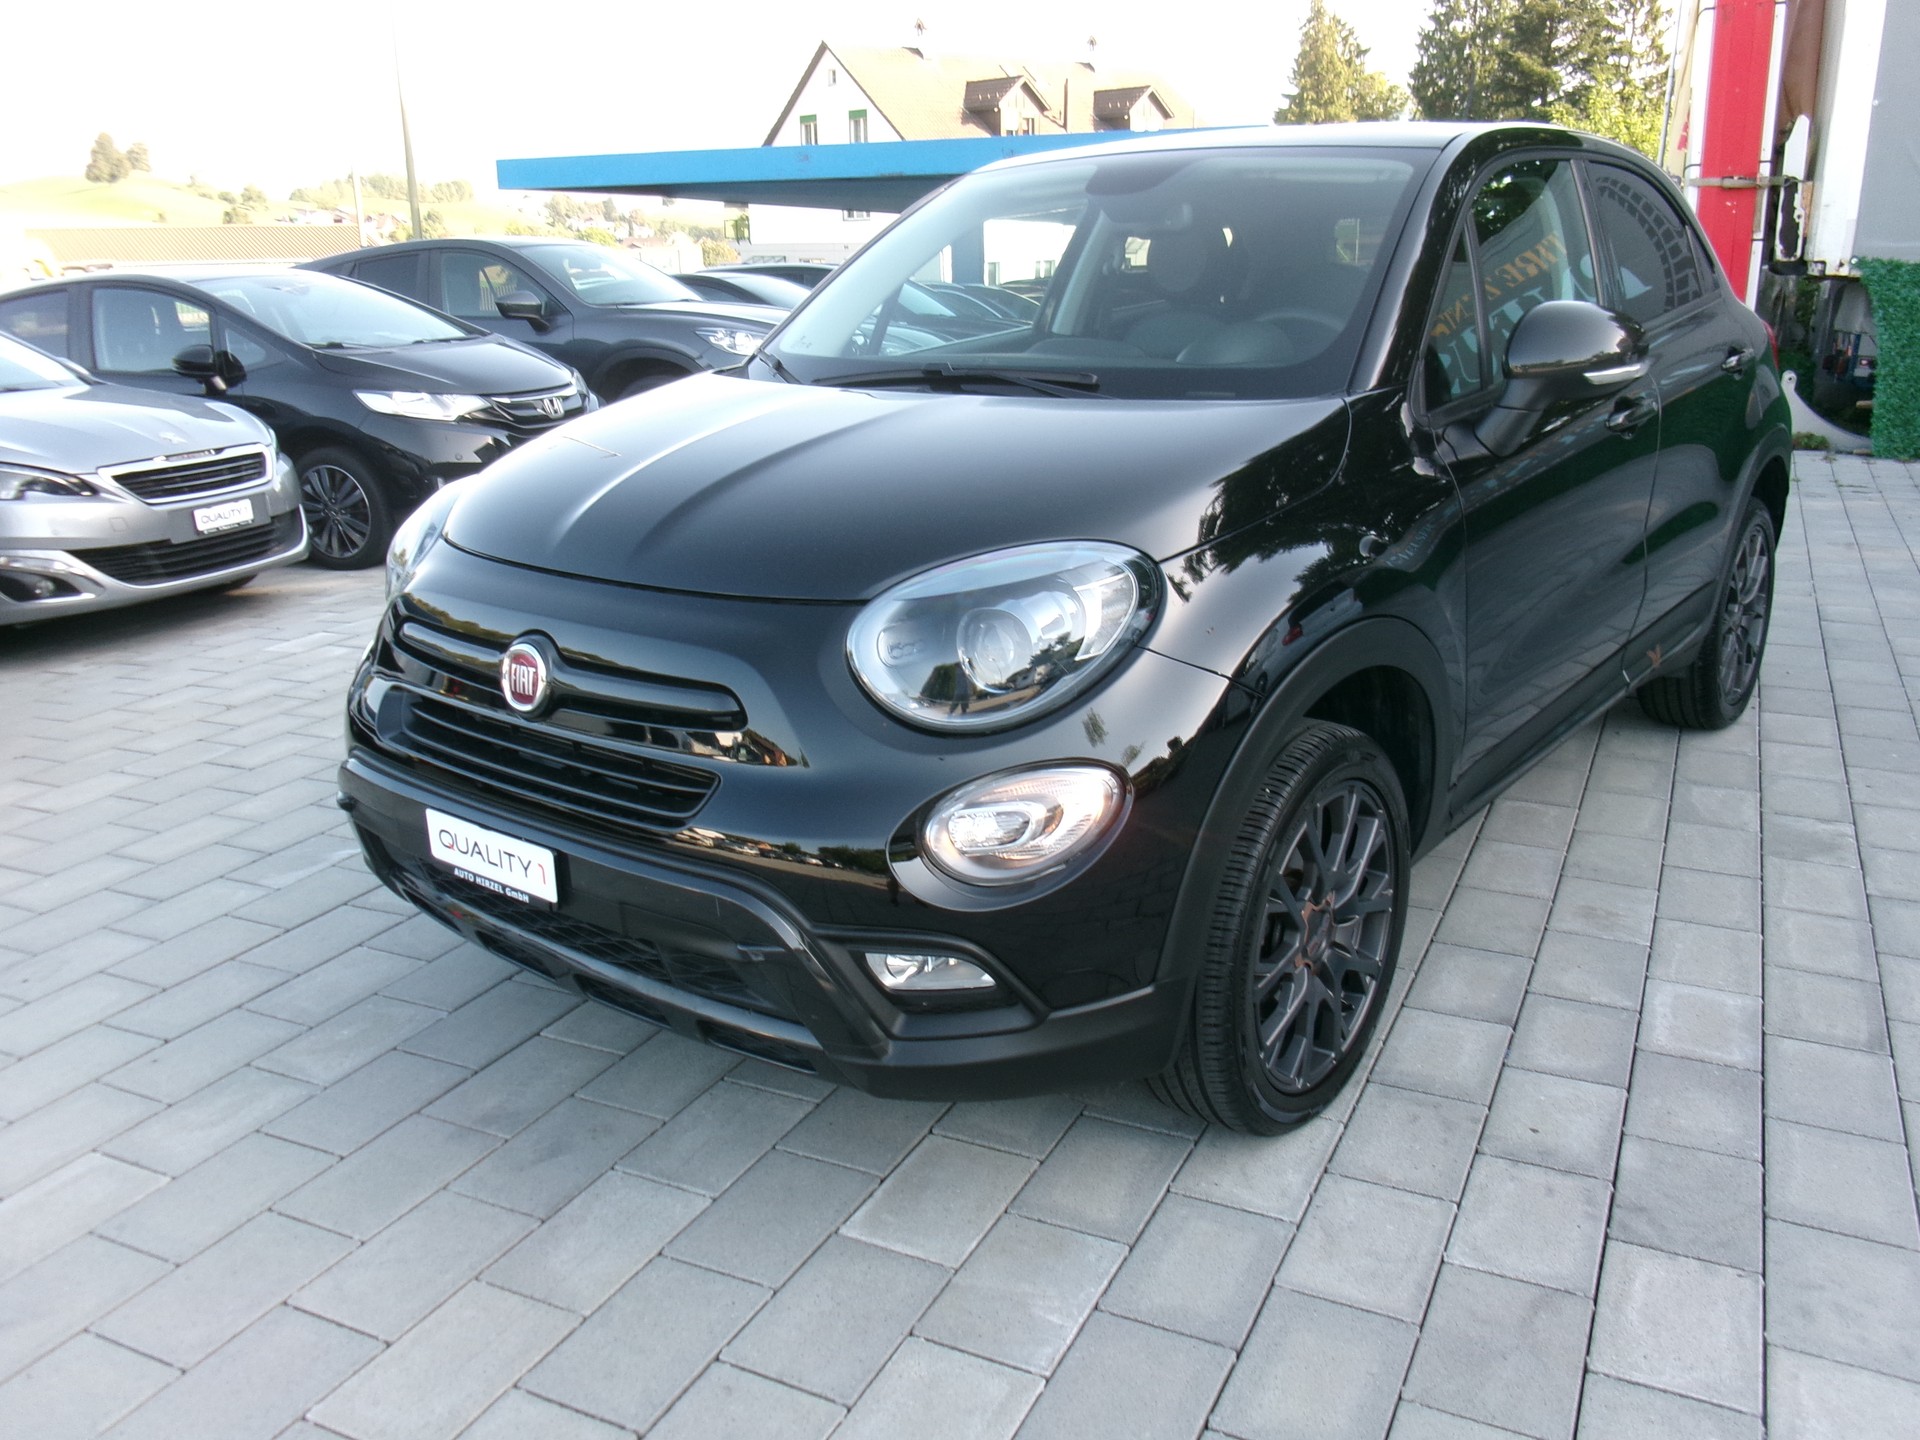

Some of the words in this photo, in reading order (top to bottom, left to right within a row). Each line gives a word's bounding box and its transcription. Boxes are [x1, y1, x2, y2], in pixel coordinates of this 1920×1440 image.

[201, 507, 242, 524] QUALITY
[511, 663, 536, 697] FIAT
[438, 829, 532, 878] QUALITY
[537, 863, 546, 885] 1
[454, 867, 474, 883] AUTO
[475, 875, 504, 894] HIRZEL
[505, 887, 529, 904] GmbH
